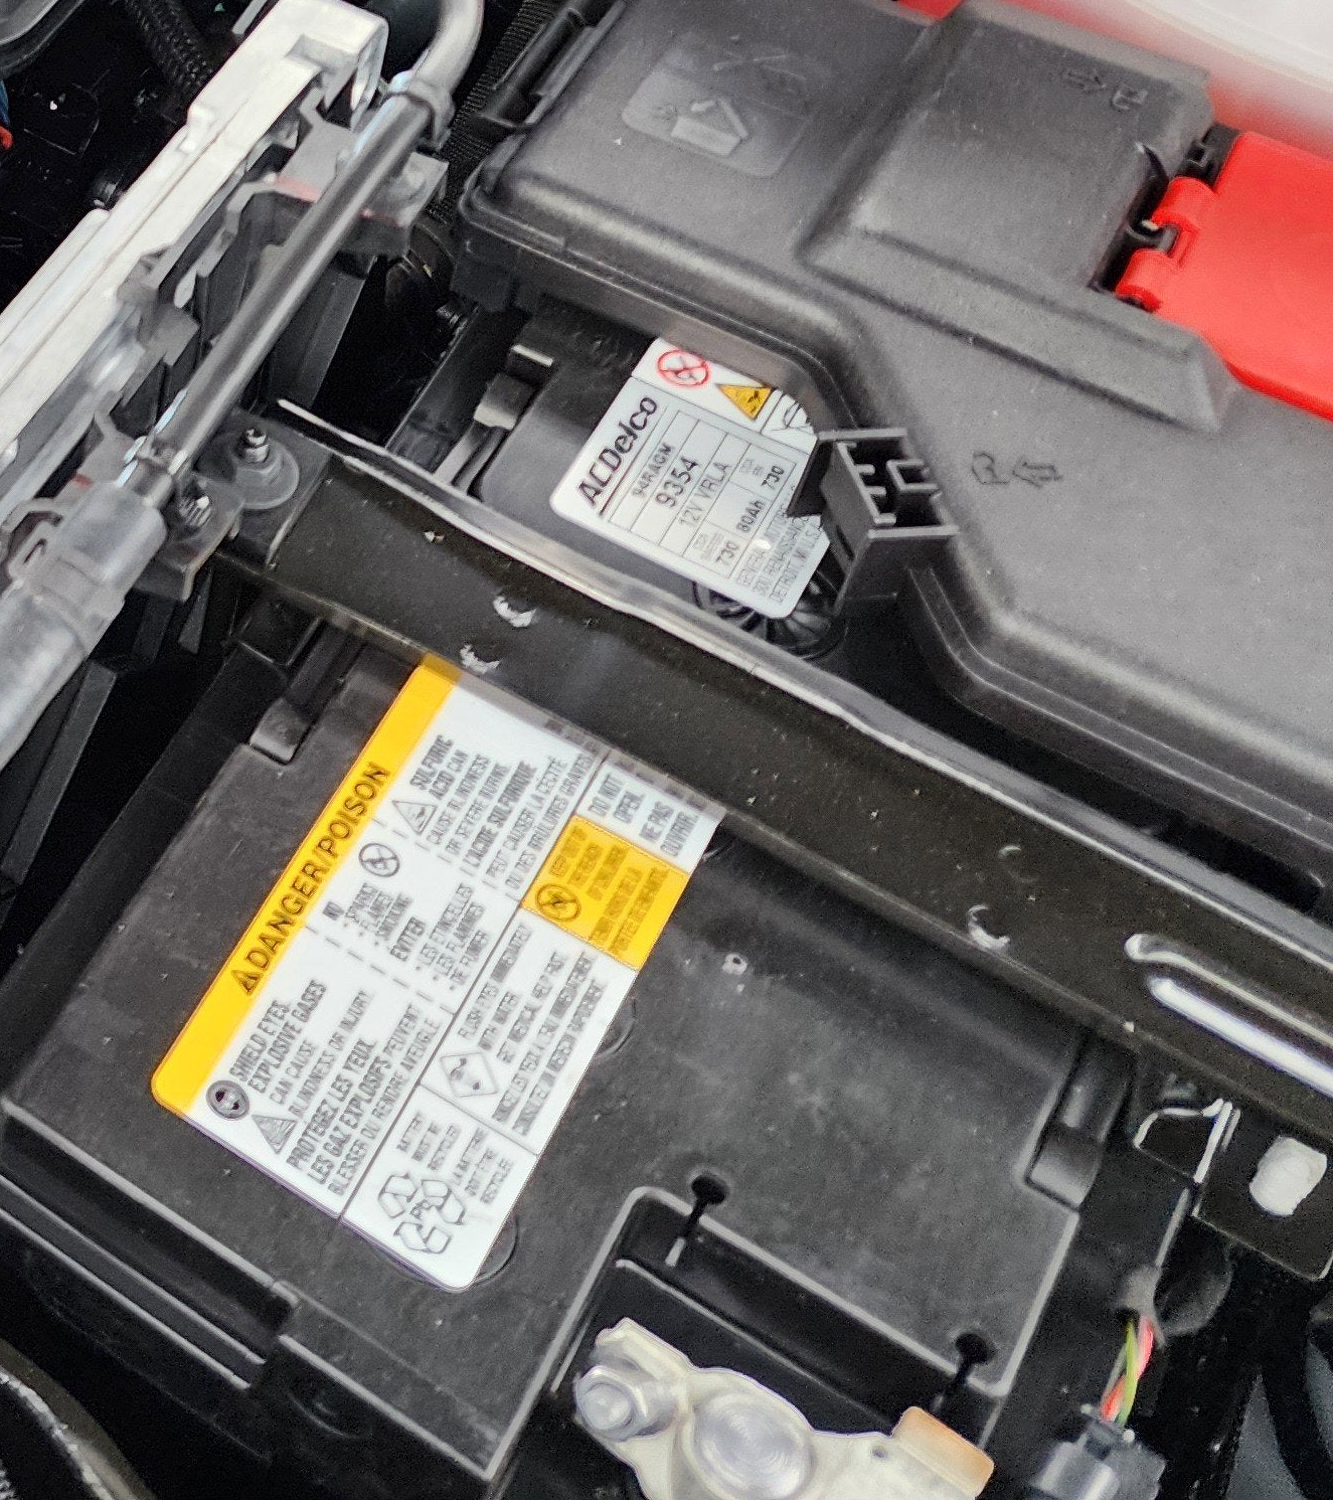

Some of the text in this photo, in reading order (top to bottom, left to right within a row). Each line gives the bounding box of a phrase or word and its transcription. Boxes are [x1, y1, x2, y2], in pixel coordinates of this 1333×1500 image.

[576, 397, 657, 503] ACDelco
[656, 459, 697, 506] 9354
[679, 503, 703, 529] 12V
[697, 462, 729, 500] VRLA
[737, 499, 763, 532] 80Ah
[411, 736, 453, 789] SULFURIC
[428, 749, 469, 799] ACID CAN
[487, 762, 535, 826] SULFURIQUE
[245, 762, 389, 969] DANGER/POISON
[230, 1034, 267, 1080] SHIELD
[249, 980, 326, 1092] EXPLOSIVE GASES
[327, 1075, 352, 1101] LES
[307, 1155, 333, 1184] LES
[323, 1126, 350, 1156] GAZ
[341, 1057, 390, 1127] EXPLOSIFS
